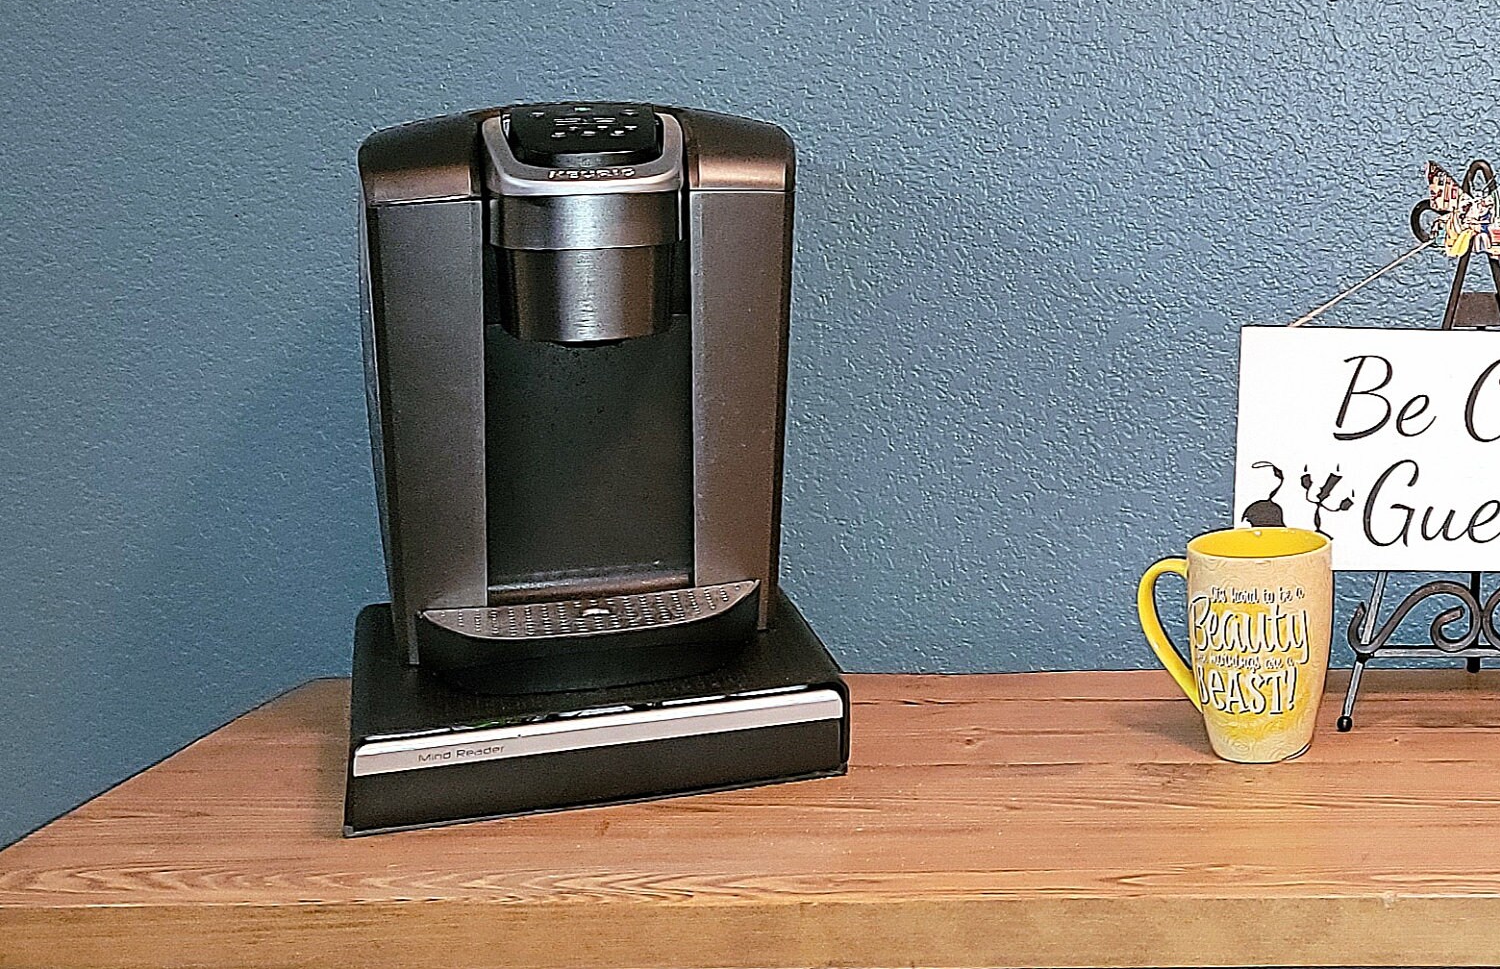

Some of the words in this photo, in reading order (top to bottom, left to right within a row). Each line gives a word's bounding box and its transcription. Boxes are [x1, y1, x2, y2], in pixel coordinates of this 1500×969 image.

[1332, 355, 1437, 441] Be
[1190, 596, 1311, 665] Beauty
[418, 751, 452, 763] Mind
[456, 745, 505, 759] Reader
